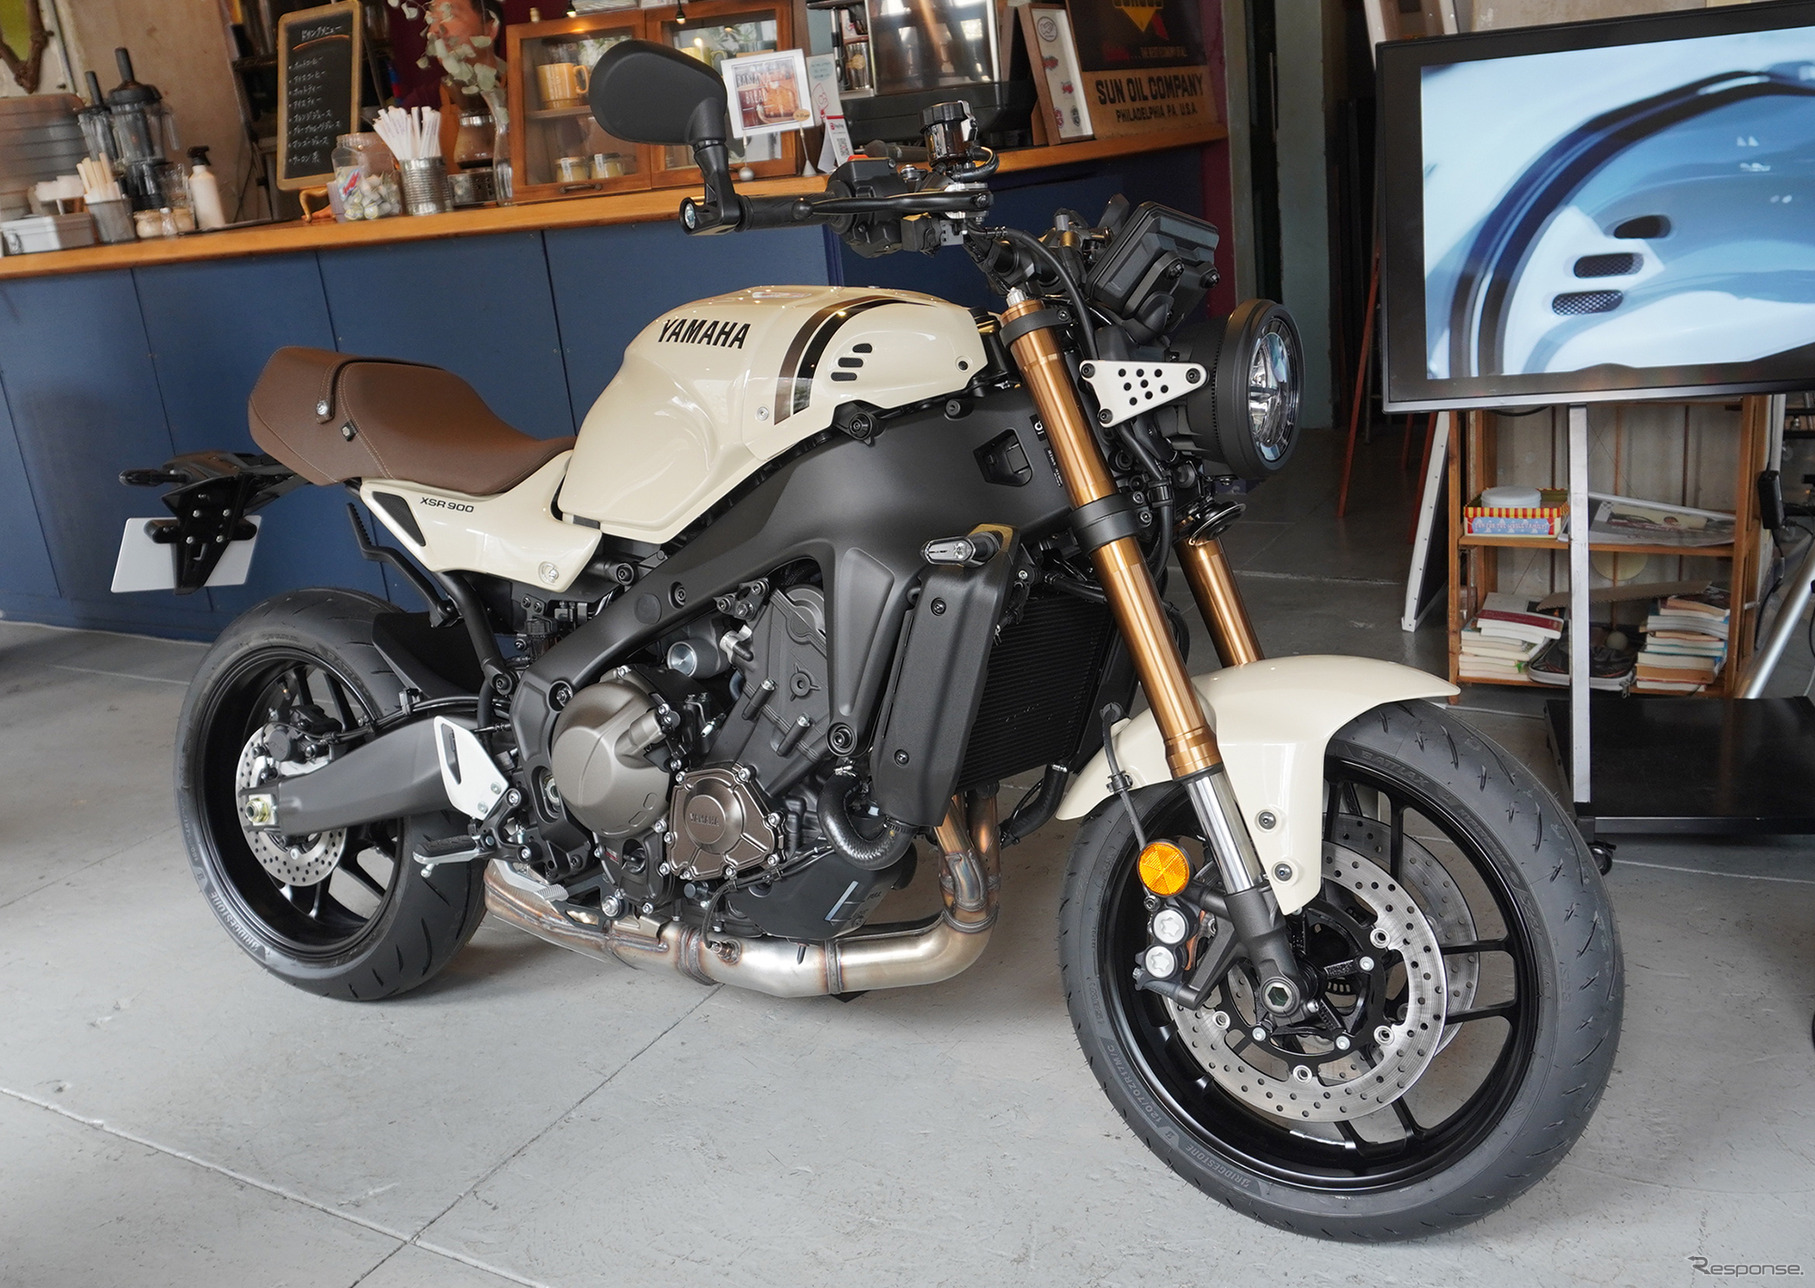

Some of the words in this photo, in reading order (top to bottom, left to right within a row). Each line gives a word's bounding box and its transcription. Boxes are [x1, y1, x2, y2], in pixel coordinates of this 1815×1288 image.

[1095, 79, 1125, 105] SUN
[1127, 77, 1148, 102] OIL
[1148, 73, 1203, 100] COMPANY
[658, 319, 751, 349] YAMAHA
[420, 497, 446, 508] XSR
[447, 502, 474, 513] 900
[209, 890, 261, 952] BRIDGESTONE
[1185, 1144, 1252, 1188] BRIDGESTONE
